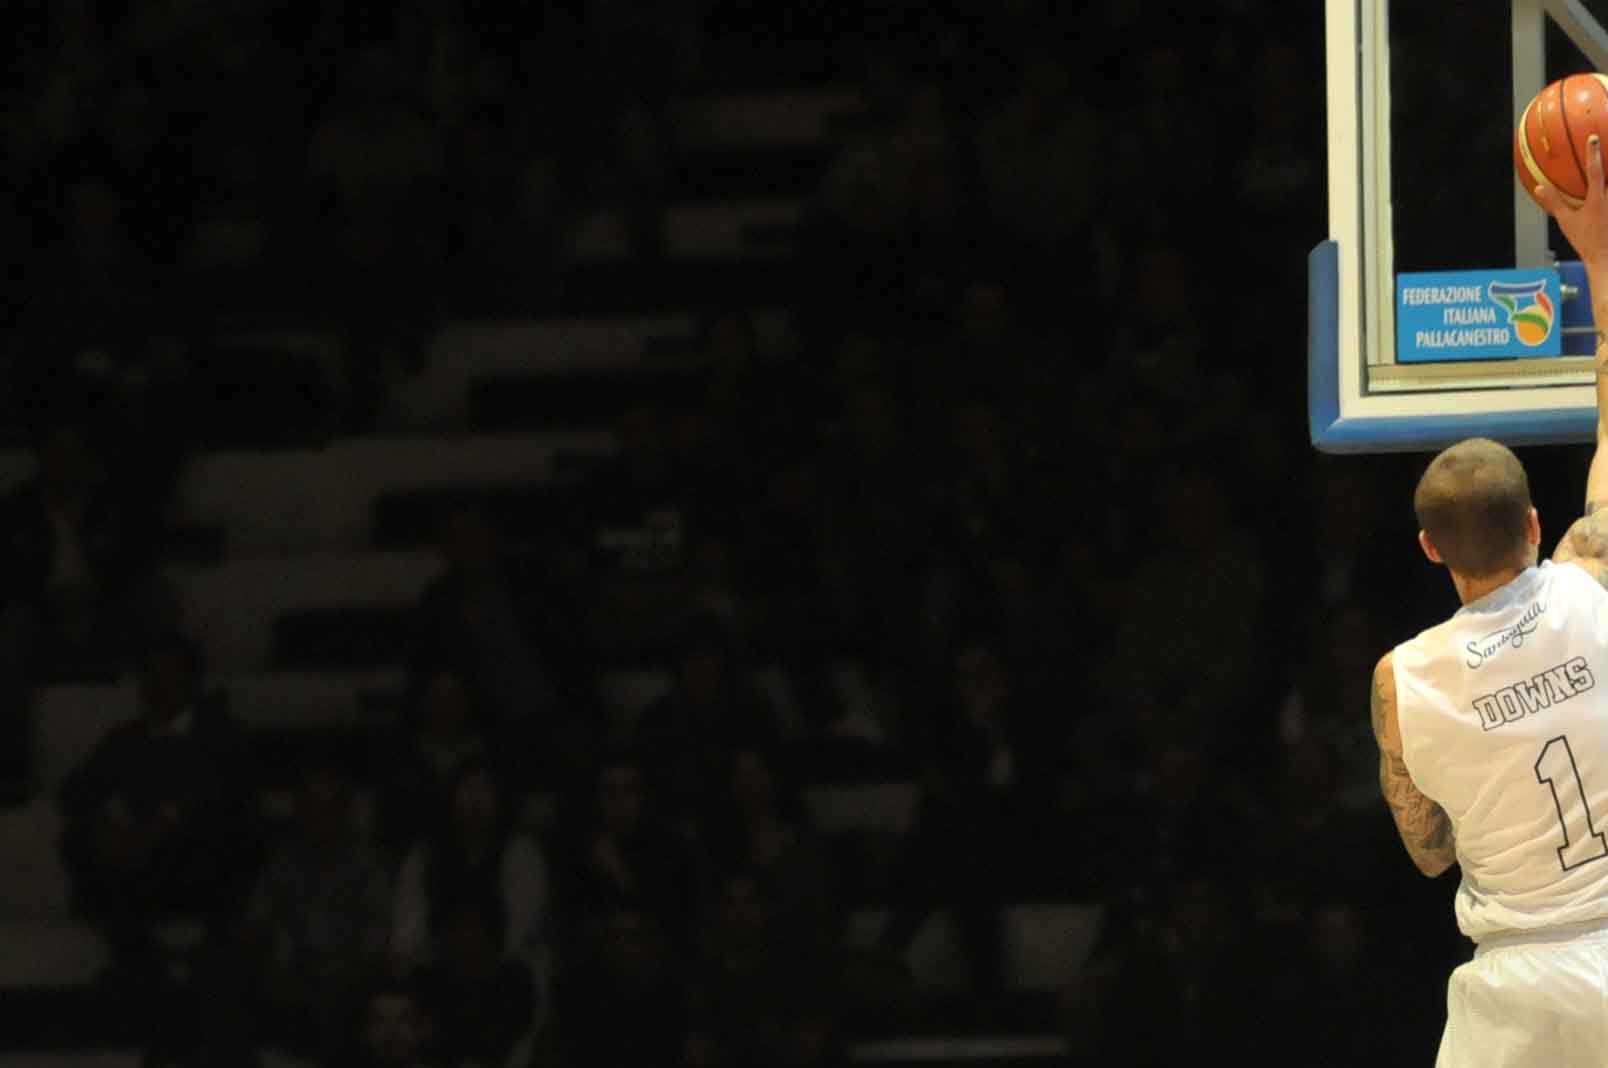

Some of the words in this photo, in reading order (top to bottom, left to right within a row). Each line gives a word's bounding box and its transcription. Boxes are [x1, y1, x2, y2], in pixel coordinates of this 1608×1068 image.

[1402, 286, 1482, 305] FEDERAZIONE
[1443, 307, 1496, 325] ITALIANA
[1415, 328, 1510, 348] PALLACANESTRO
[1472, 656, 1595, 731] DOWNS
[1534, 734, 1608, 872] 1
